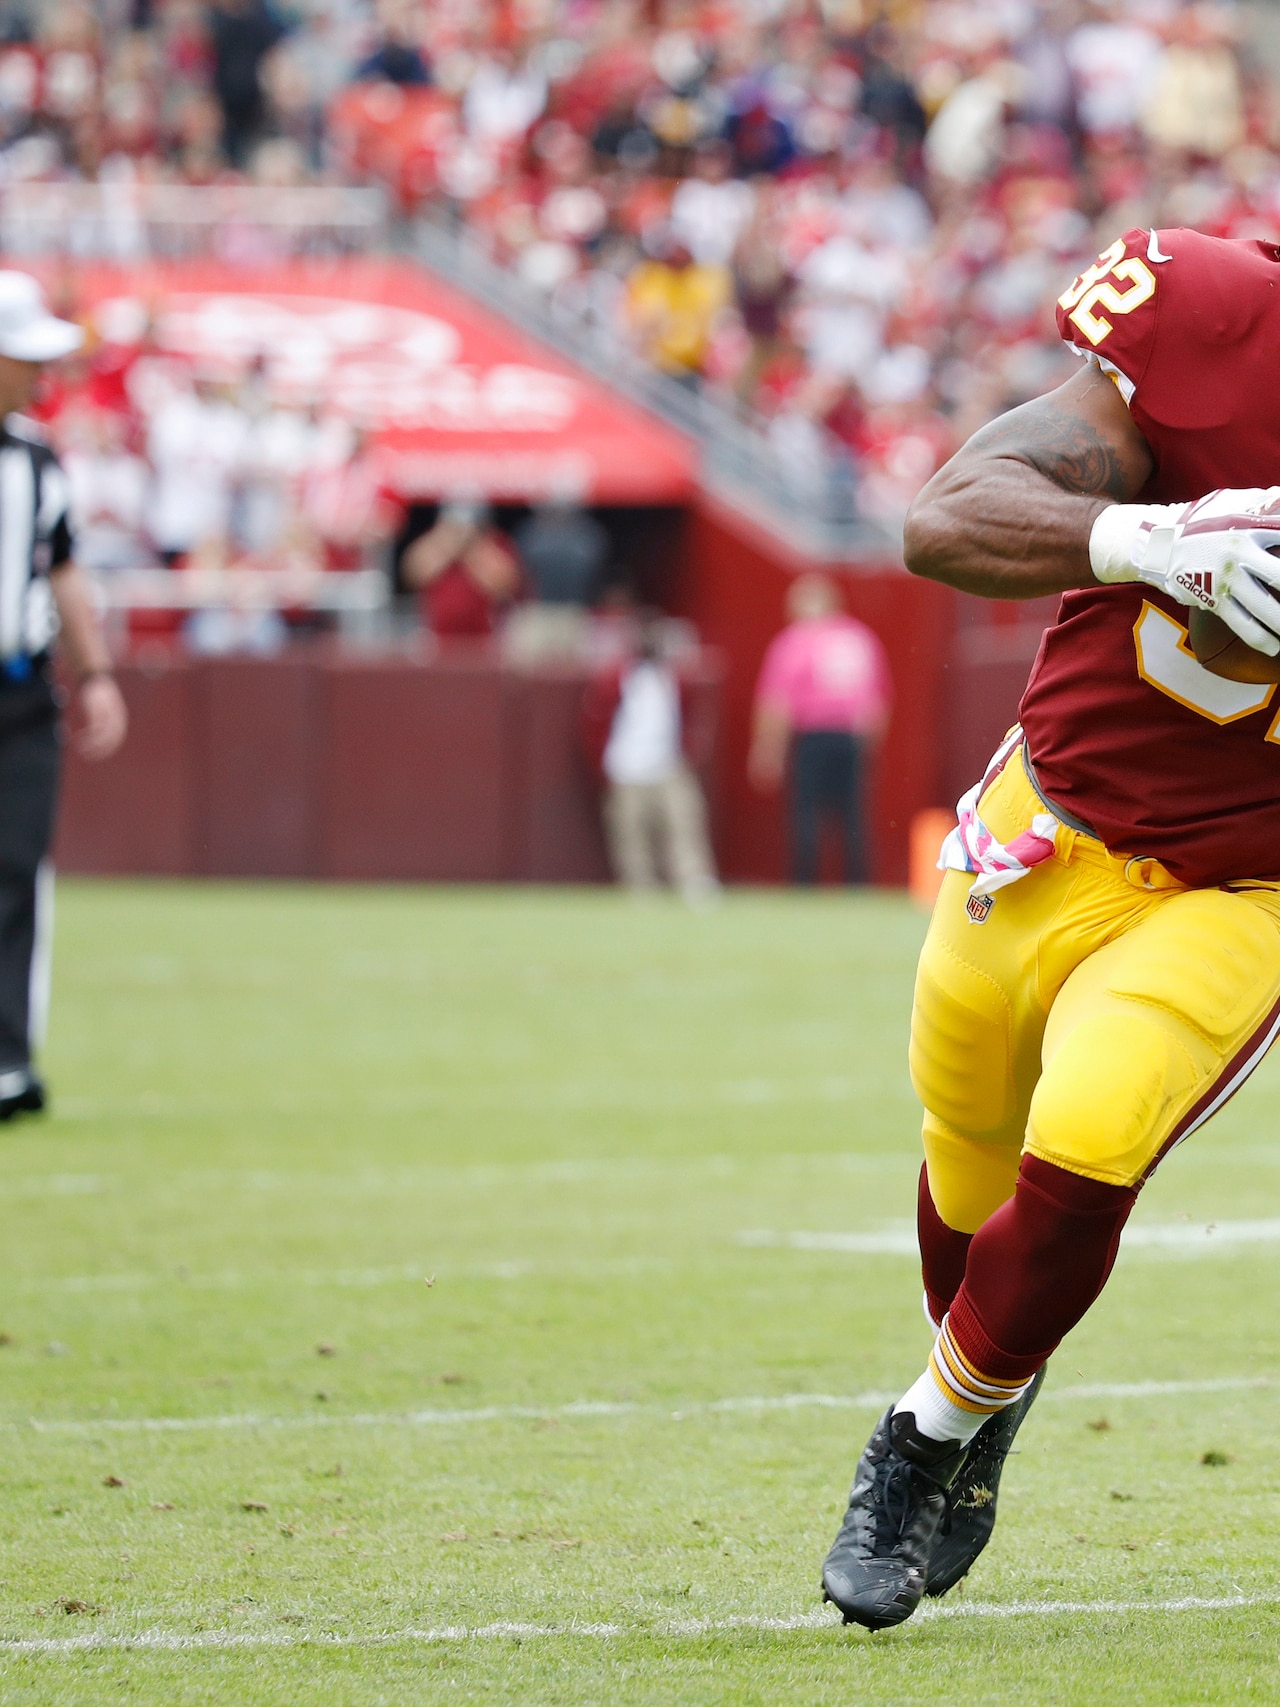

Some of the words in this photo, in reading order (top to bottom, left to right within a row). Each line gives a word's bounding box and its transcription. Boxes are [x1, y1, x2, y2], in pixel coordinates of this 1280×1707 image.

[1057, 238, 1156, 346] 32
[1175, 573, 1216, 608] adidas
[968, 898, 985, 919] NFL
